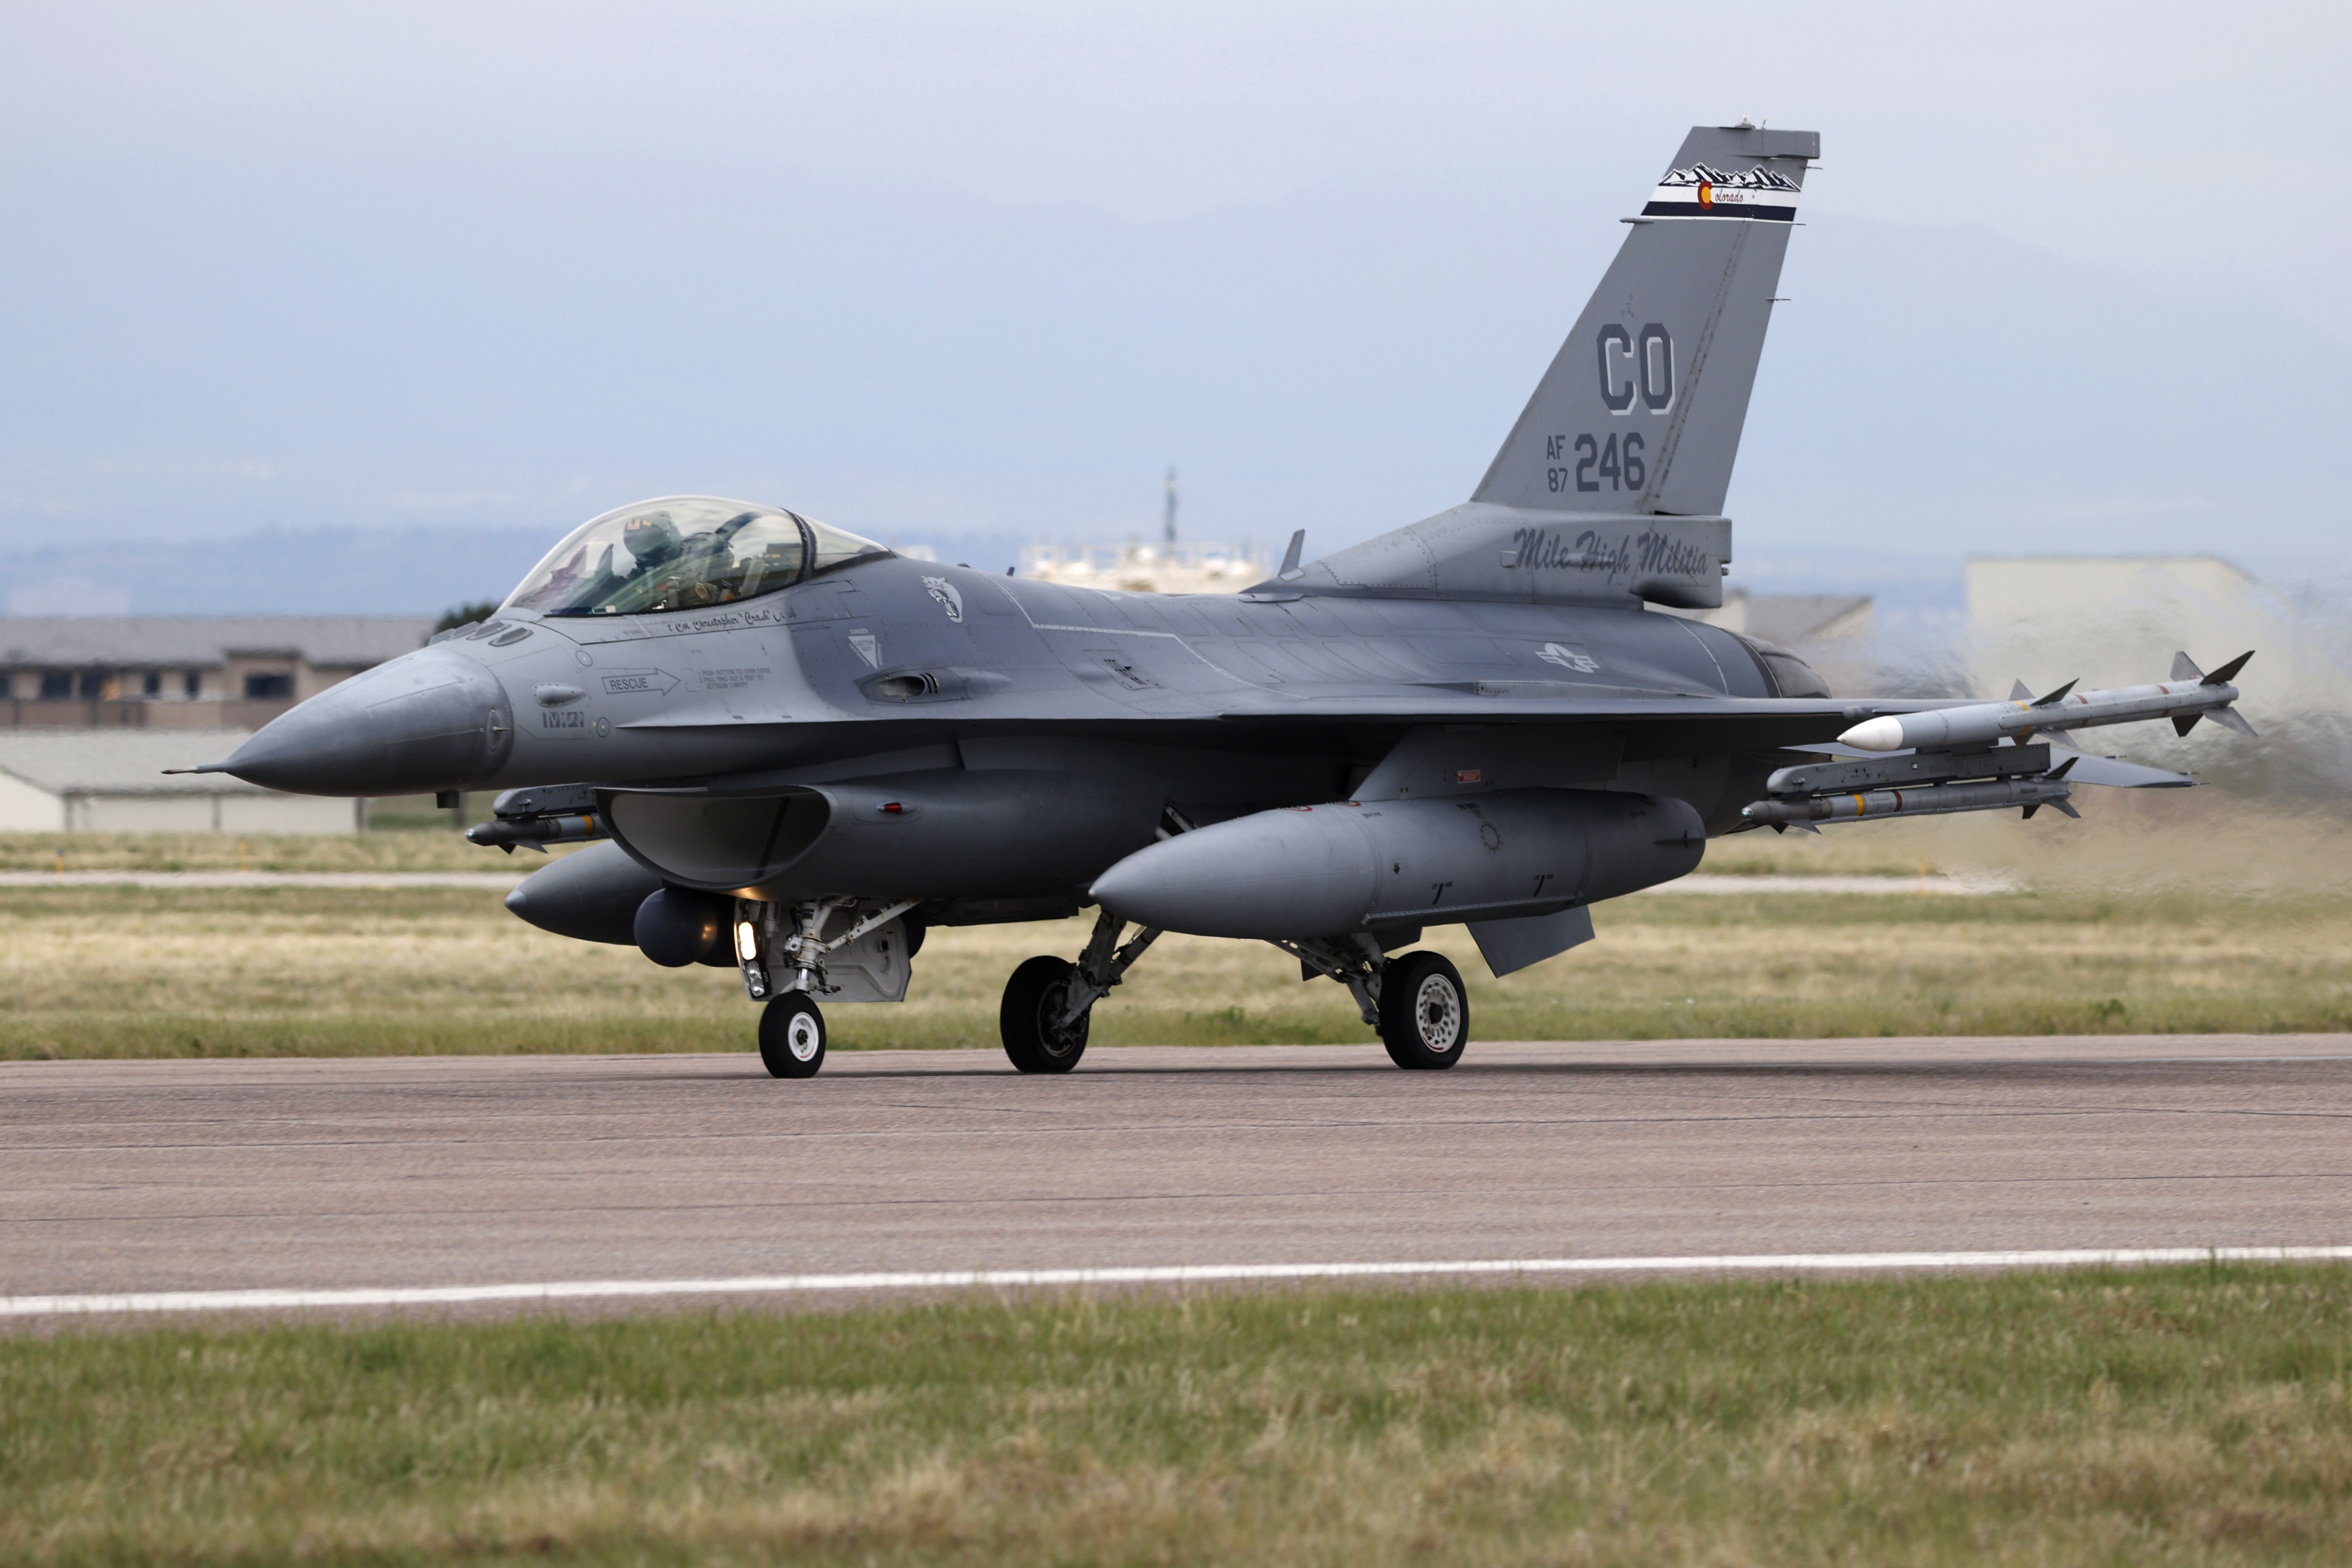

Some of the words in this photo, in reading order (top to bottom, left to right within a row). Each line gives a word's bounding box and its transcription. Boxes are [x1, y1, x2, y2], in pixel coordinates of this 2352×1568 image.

[1597, 323, 1676, 416] CO
[1547, 435, 1565, 460] AF
[1574, 432, 1645, 492] 246
[1548, 467, 1568, 492] 87
[1514, 528, 1570, 570] Mile
[1575, 530, 1631, 585] High
[1637, 532, 1708, 575] Militia
[609, 677, 648, 691] RESCUE
